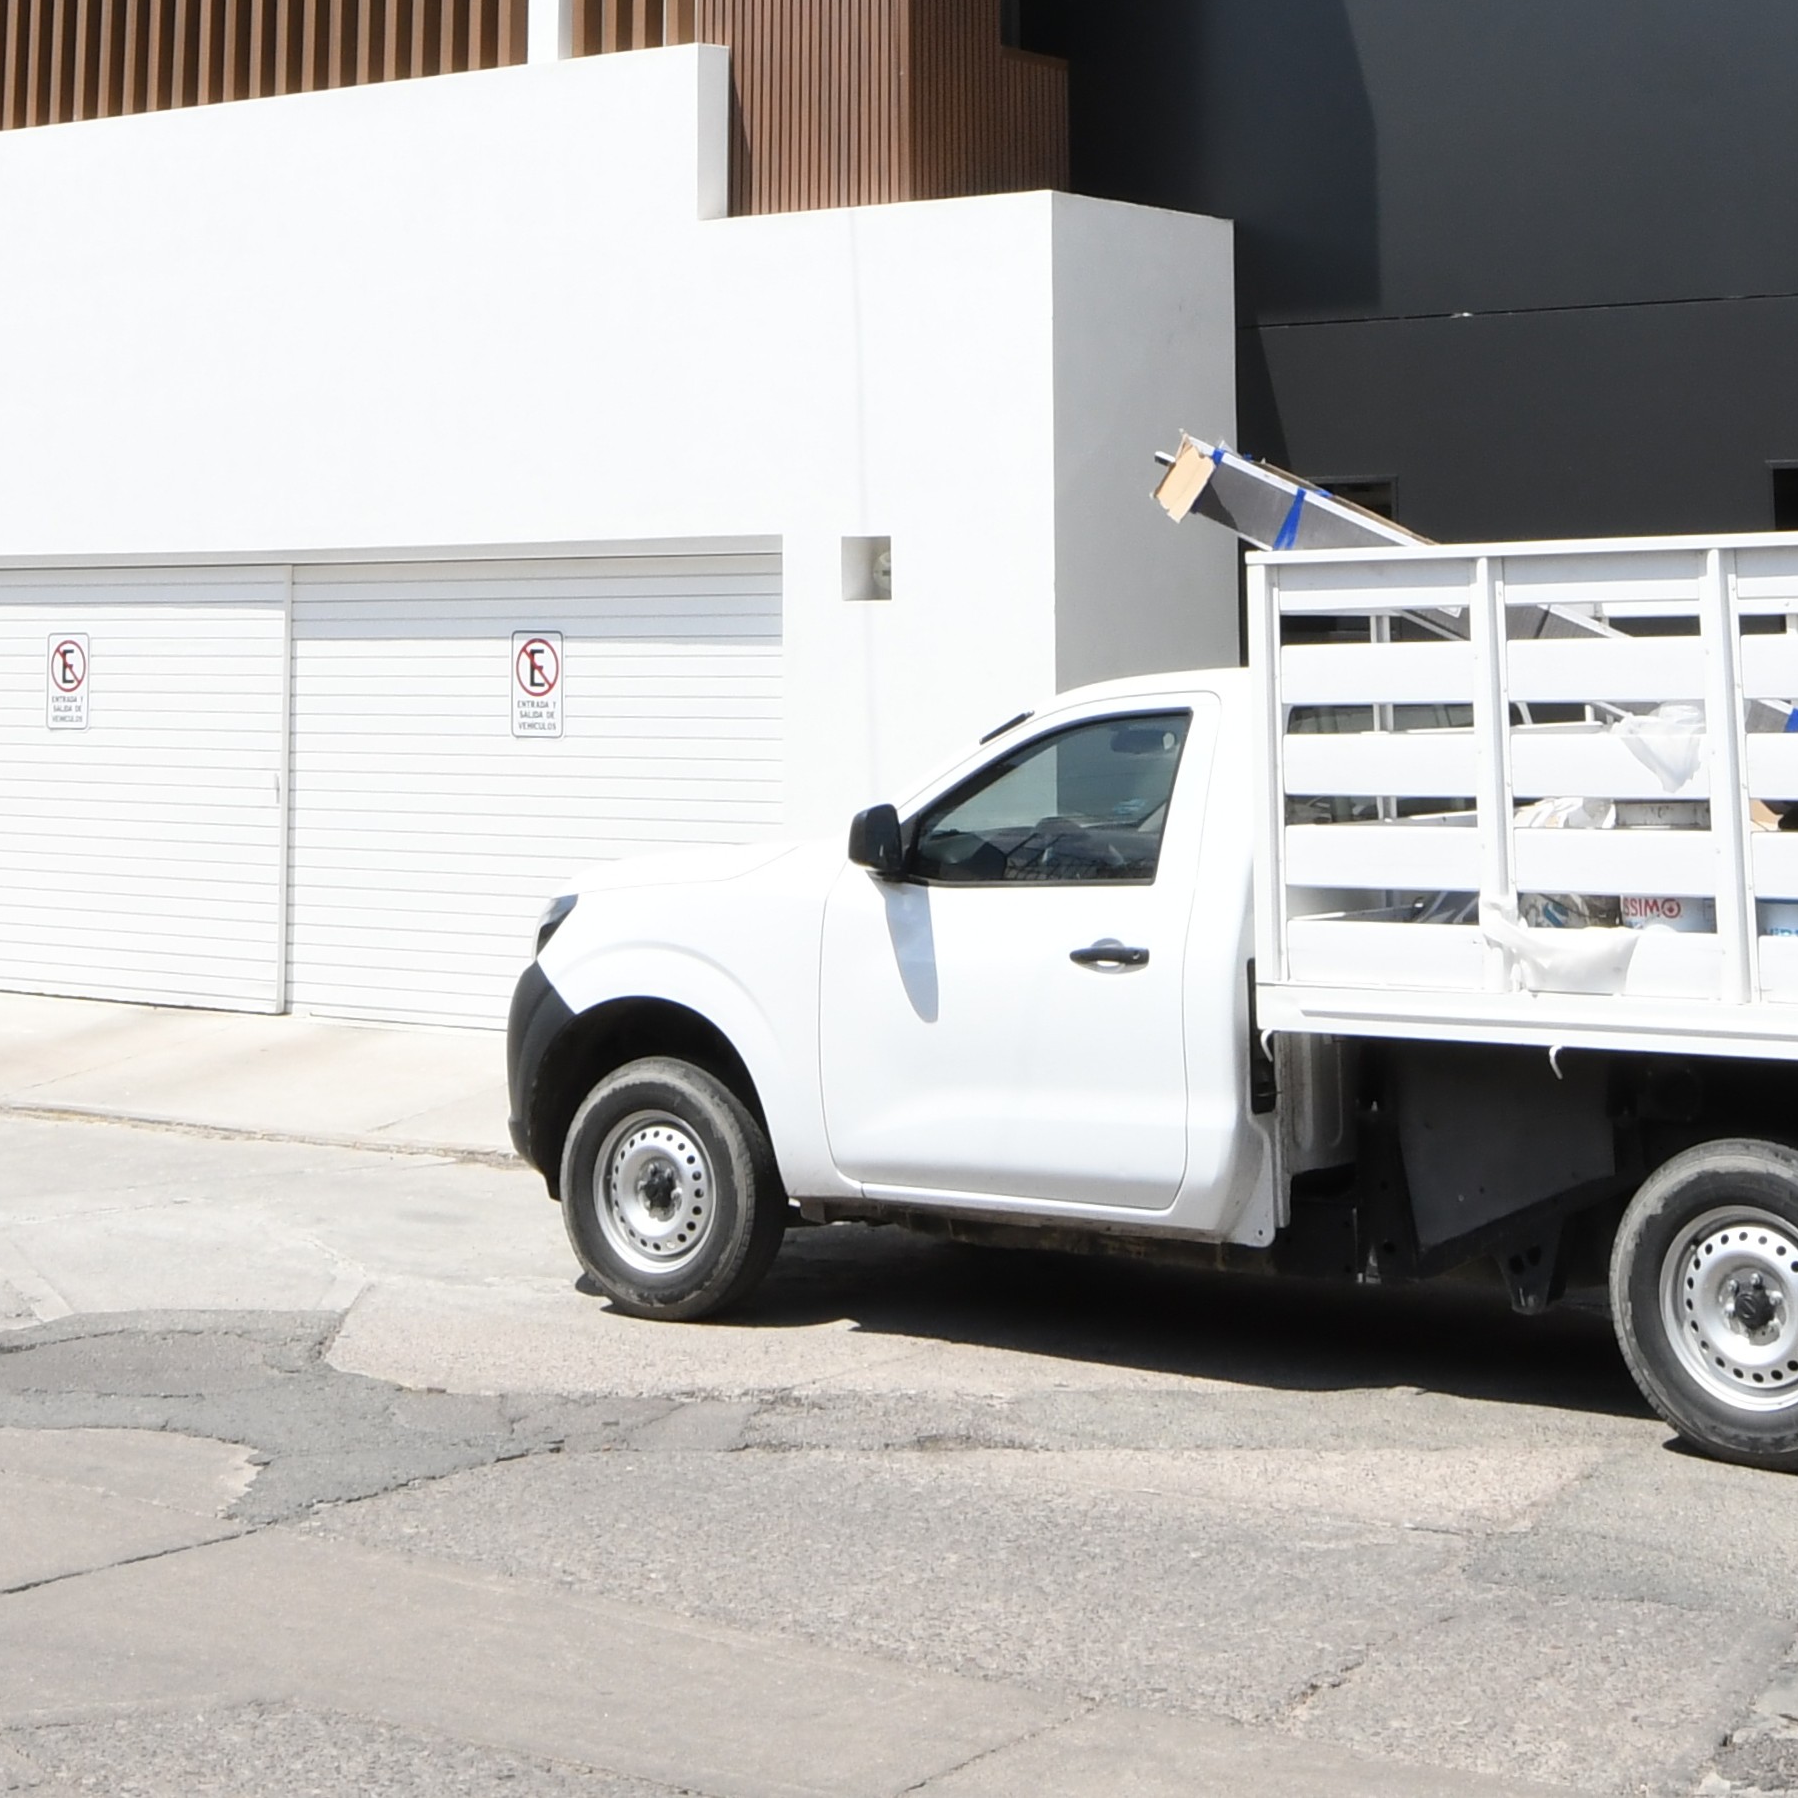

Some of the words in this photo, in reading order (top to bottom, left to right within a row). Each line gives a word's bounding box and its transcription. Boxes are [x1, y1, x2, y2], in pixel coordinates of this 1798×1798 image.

[517, 700, 549, 708] ENTRADA
[519, 710, 543, 719] SALIDA
[546, 711, 555, 719] DE
